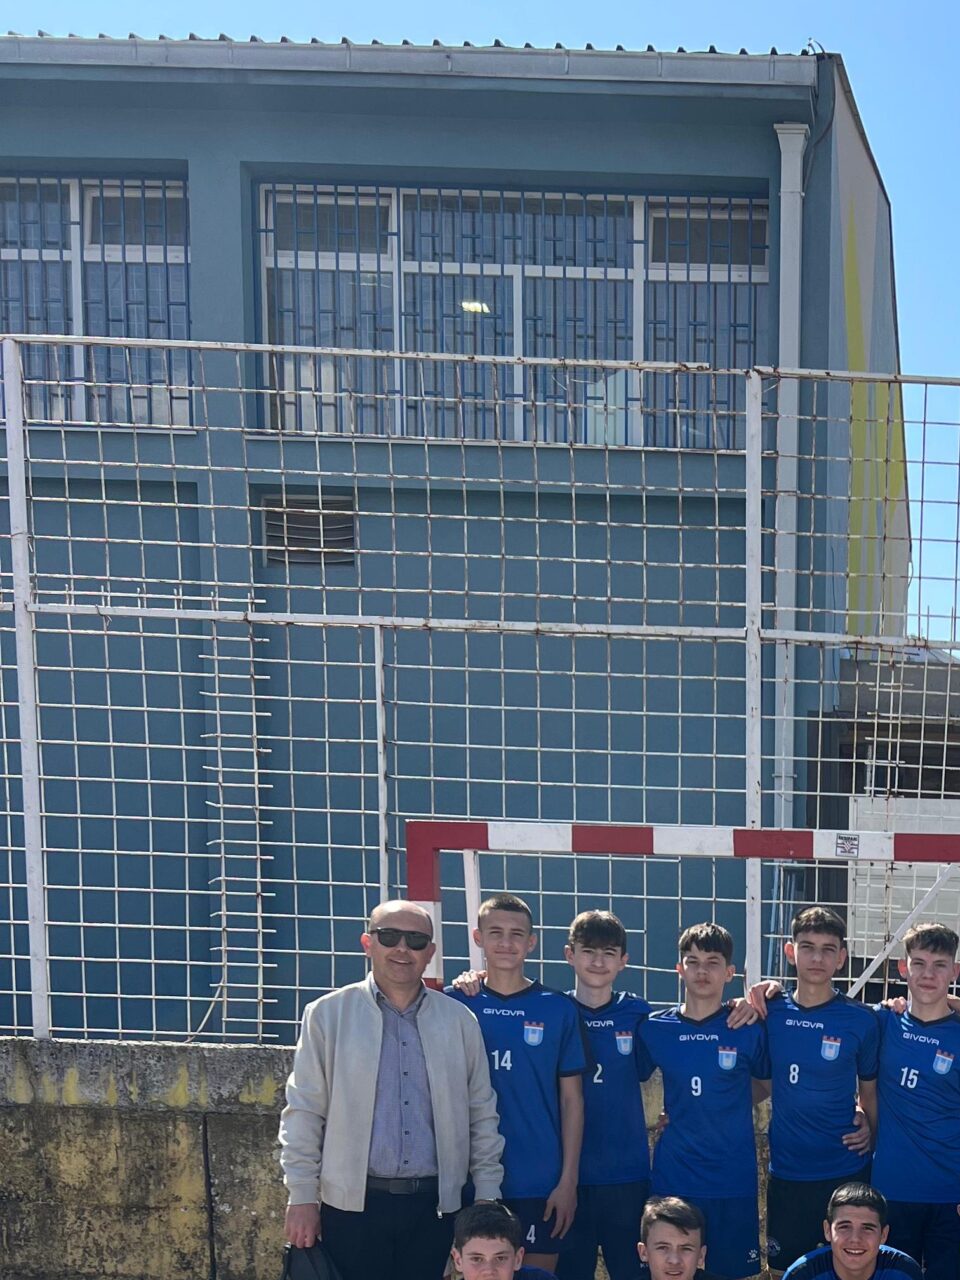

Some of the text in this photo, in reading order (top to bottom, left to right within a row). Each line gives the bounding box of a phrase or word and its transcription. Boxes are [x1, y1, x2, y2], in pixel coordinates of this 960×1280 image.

[483, 1008, 525, 1016] GIVOVA
[785, 1018, 825, 1029] GIVOVA
[903, 1031, 940, 1046] GIVOVA
[491, 1049, 513, 1071] 14
[789, 1063, 800, 1084] 8
[900, 1066, 919, 1089] 15
[690, 1076, 702, 1097] 9
